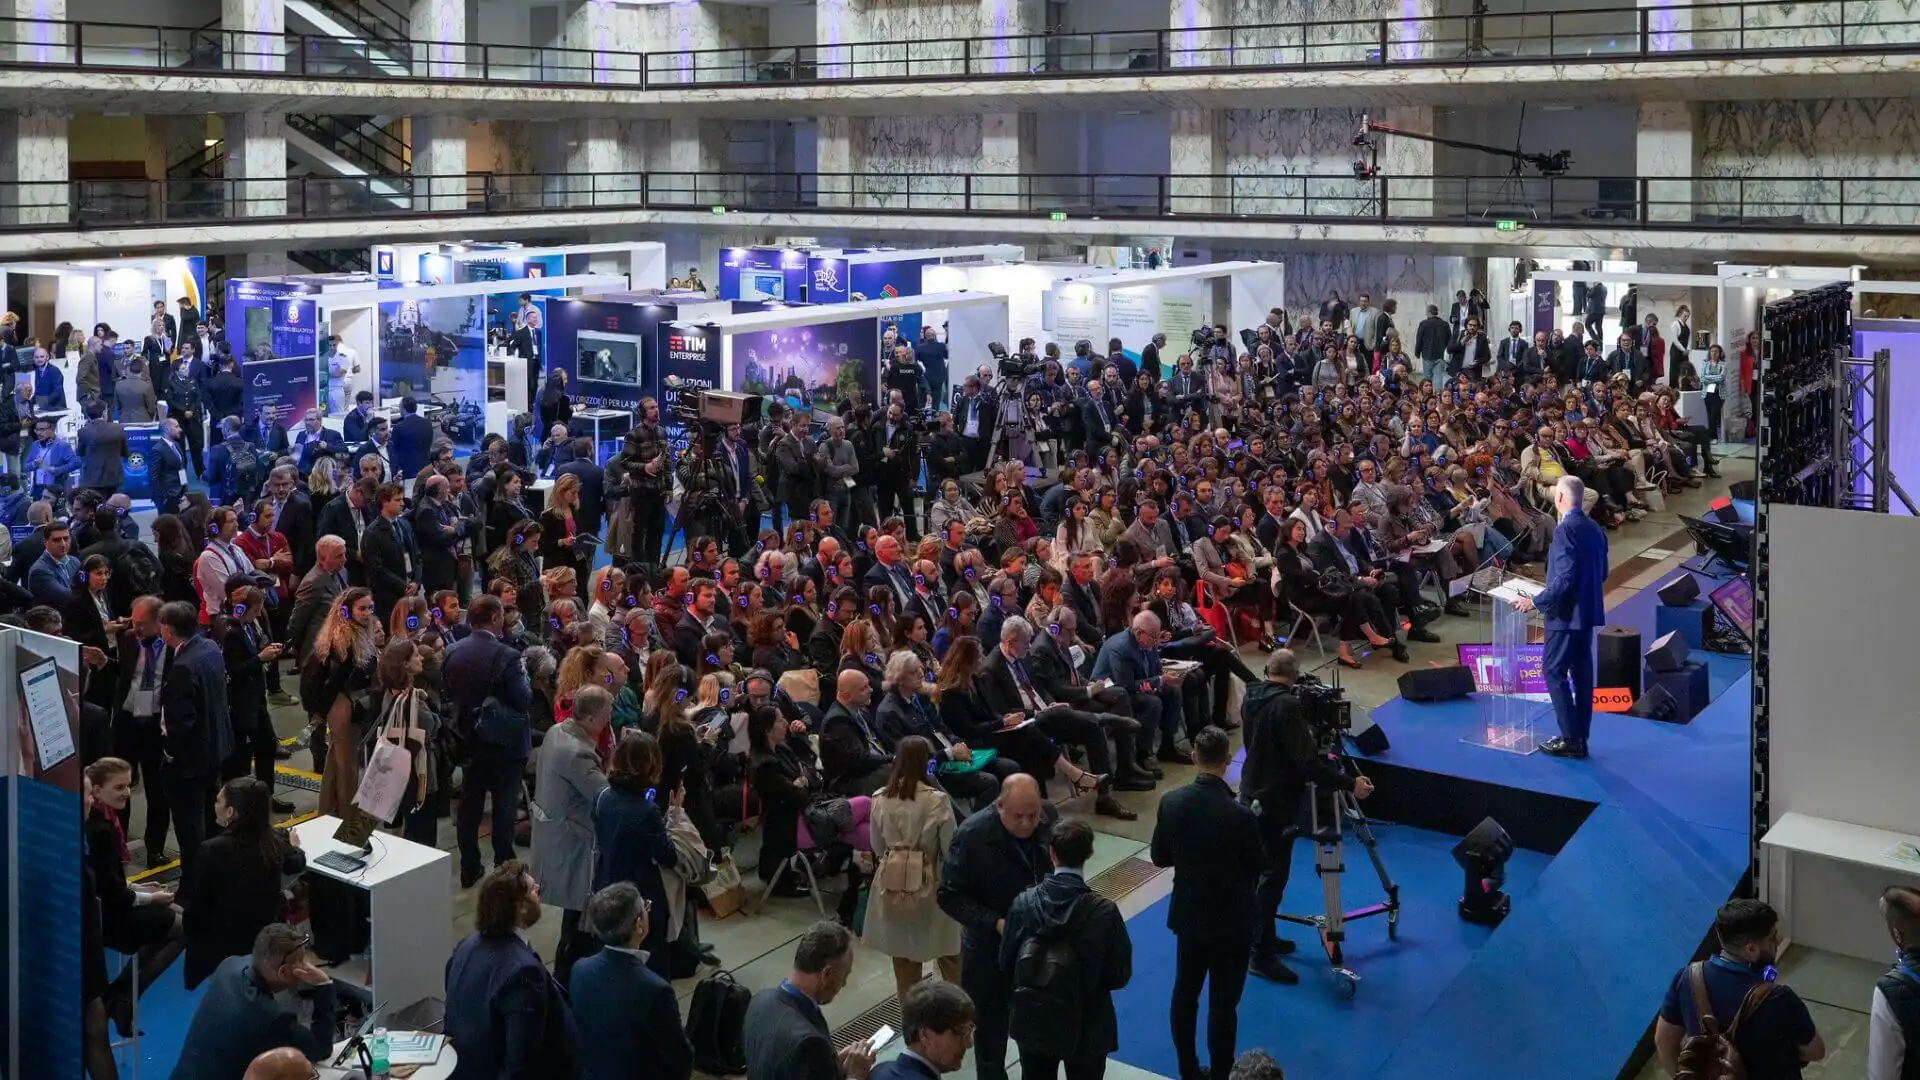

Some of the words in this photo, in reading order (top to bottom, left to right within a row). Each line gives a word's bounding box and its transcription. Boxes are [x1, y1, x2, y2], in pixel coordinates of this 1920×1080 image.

[683, 336, 706, 352] TIM
[669, 351, 706, 362] ENTERPRISE
[682, 378, 712, 391] UZIONI
